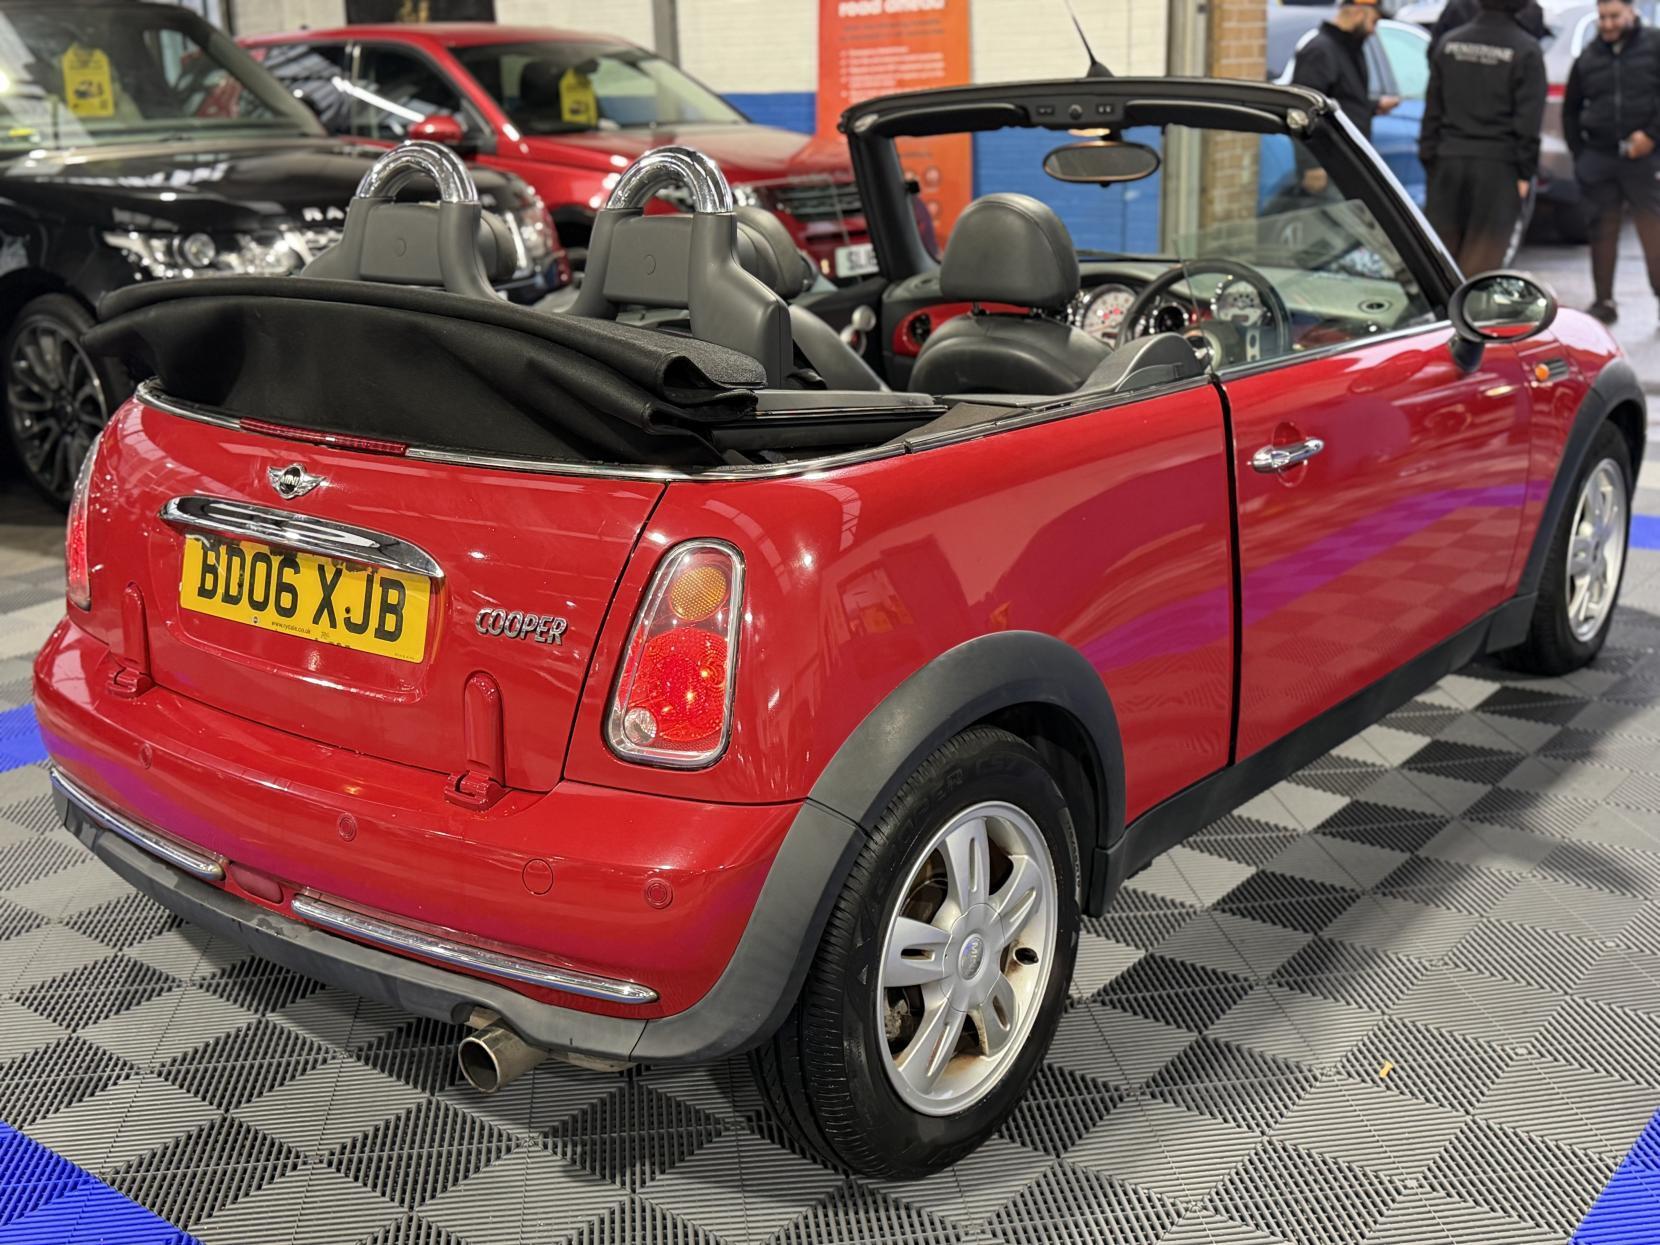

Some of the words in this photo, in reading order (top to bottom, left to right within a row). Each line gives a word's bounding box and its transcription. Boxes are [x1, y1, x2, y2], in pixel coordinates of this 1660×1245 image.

[197, 543, 301, 619] BD06
[312, 564, 406, 643] XJB
[475, 607, 568, 646] COOPER
